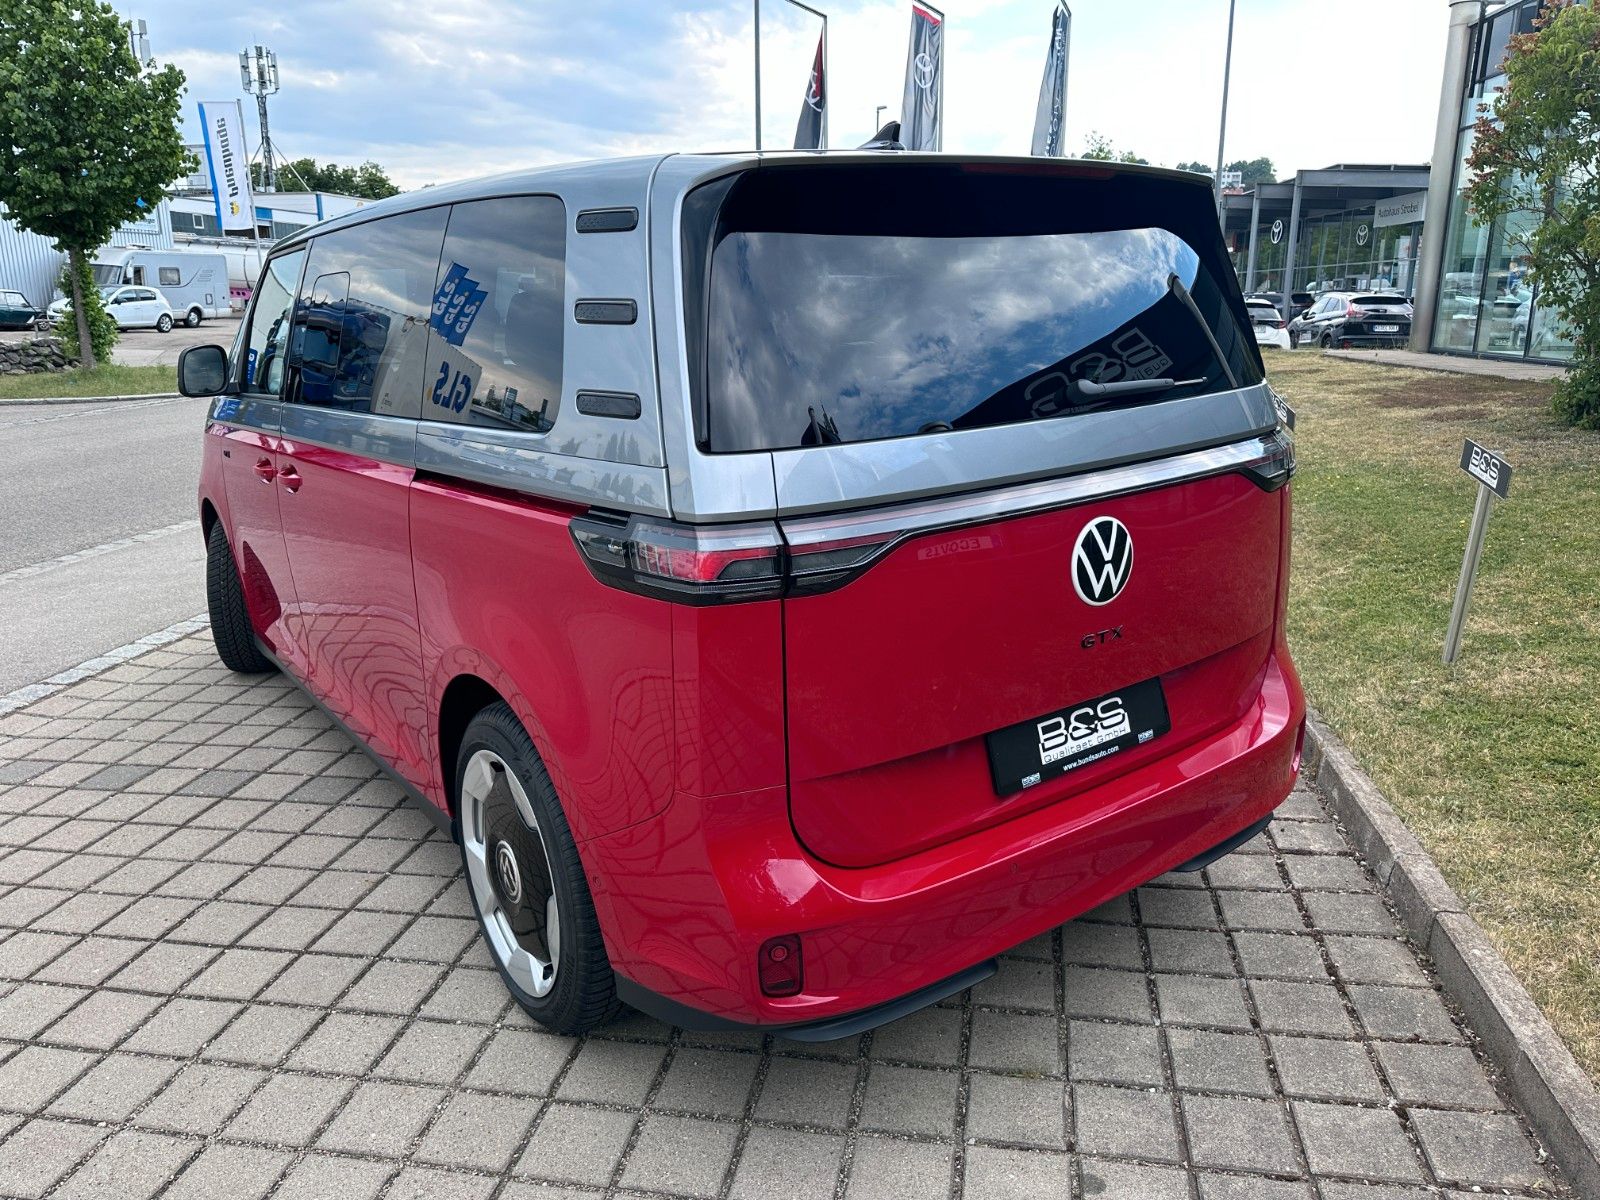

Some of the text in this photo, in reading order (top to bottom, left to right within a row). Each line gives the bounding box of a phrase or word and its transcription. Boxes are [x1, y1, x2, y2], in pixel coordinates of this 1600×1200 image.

[1378, 207, 1400, 218] Autohaus
[1470, 446, 1500, 480] B&S
[1081, 624, 1124, 649] GTX
[1037, 697, 1126, 753] B&S
[1043, 739, 1094, 763] Qualitaet
[1096, 725, 1127, 744] GmbH
[1063, 745, 1120, 771] www.bundsauto.com
